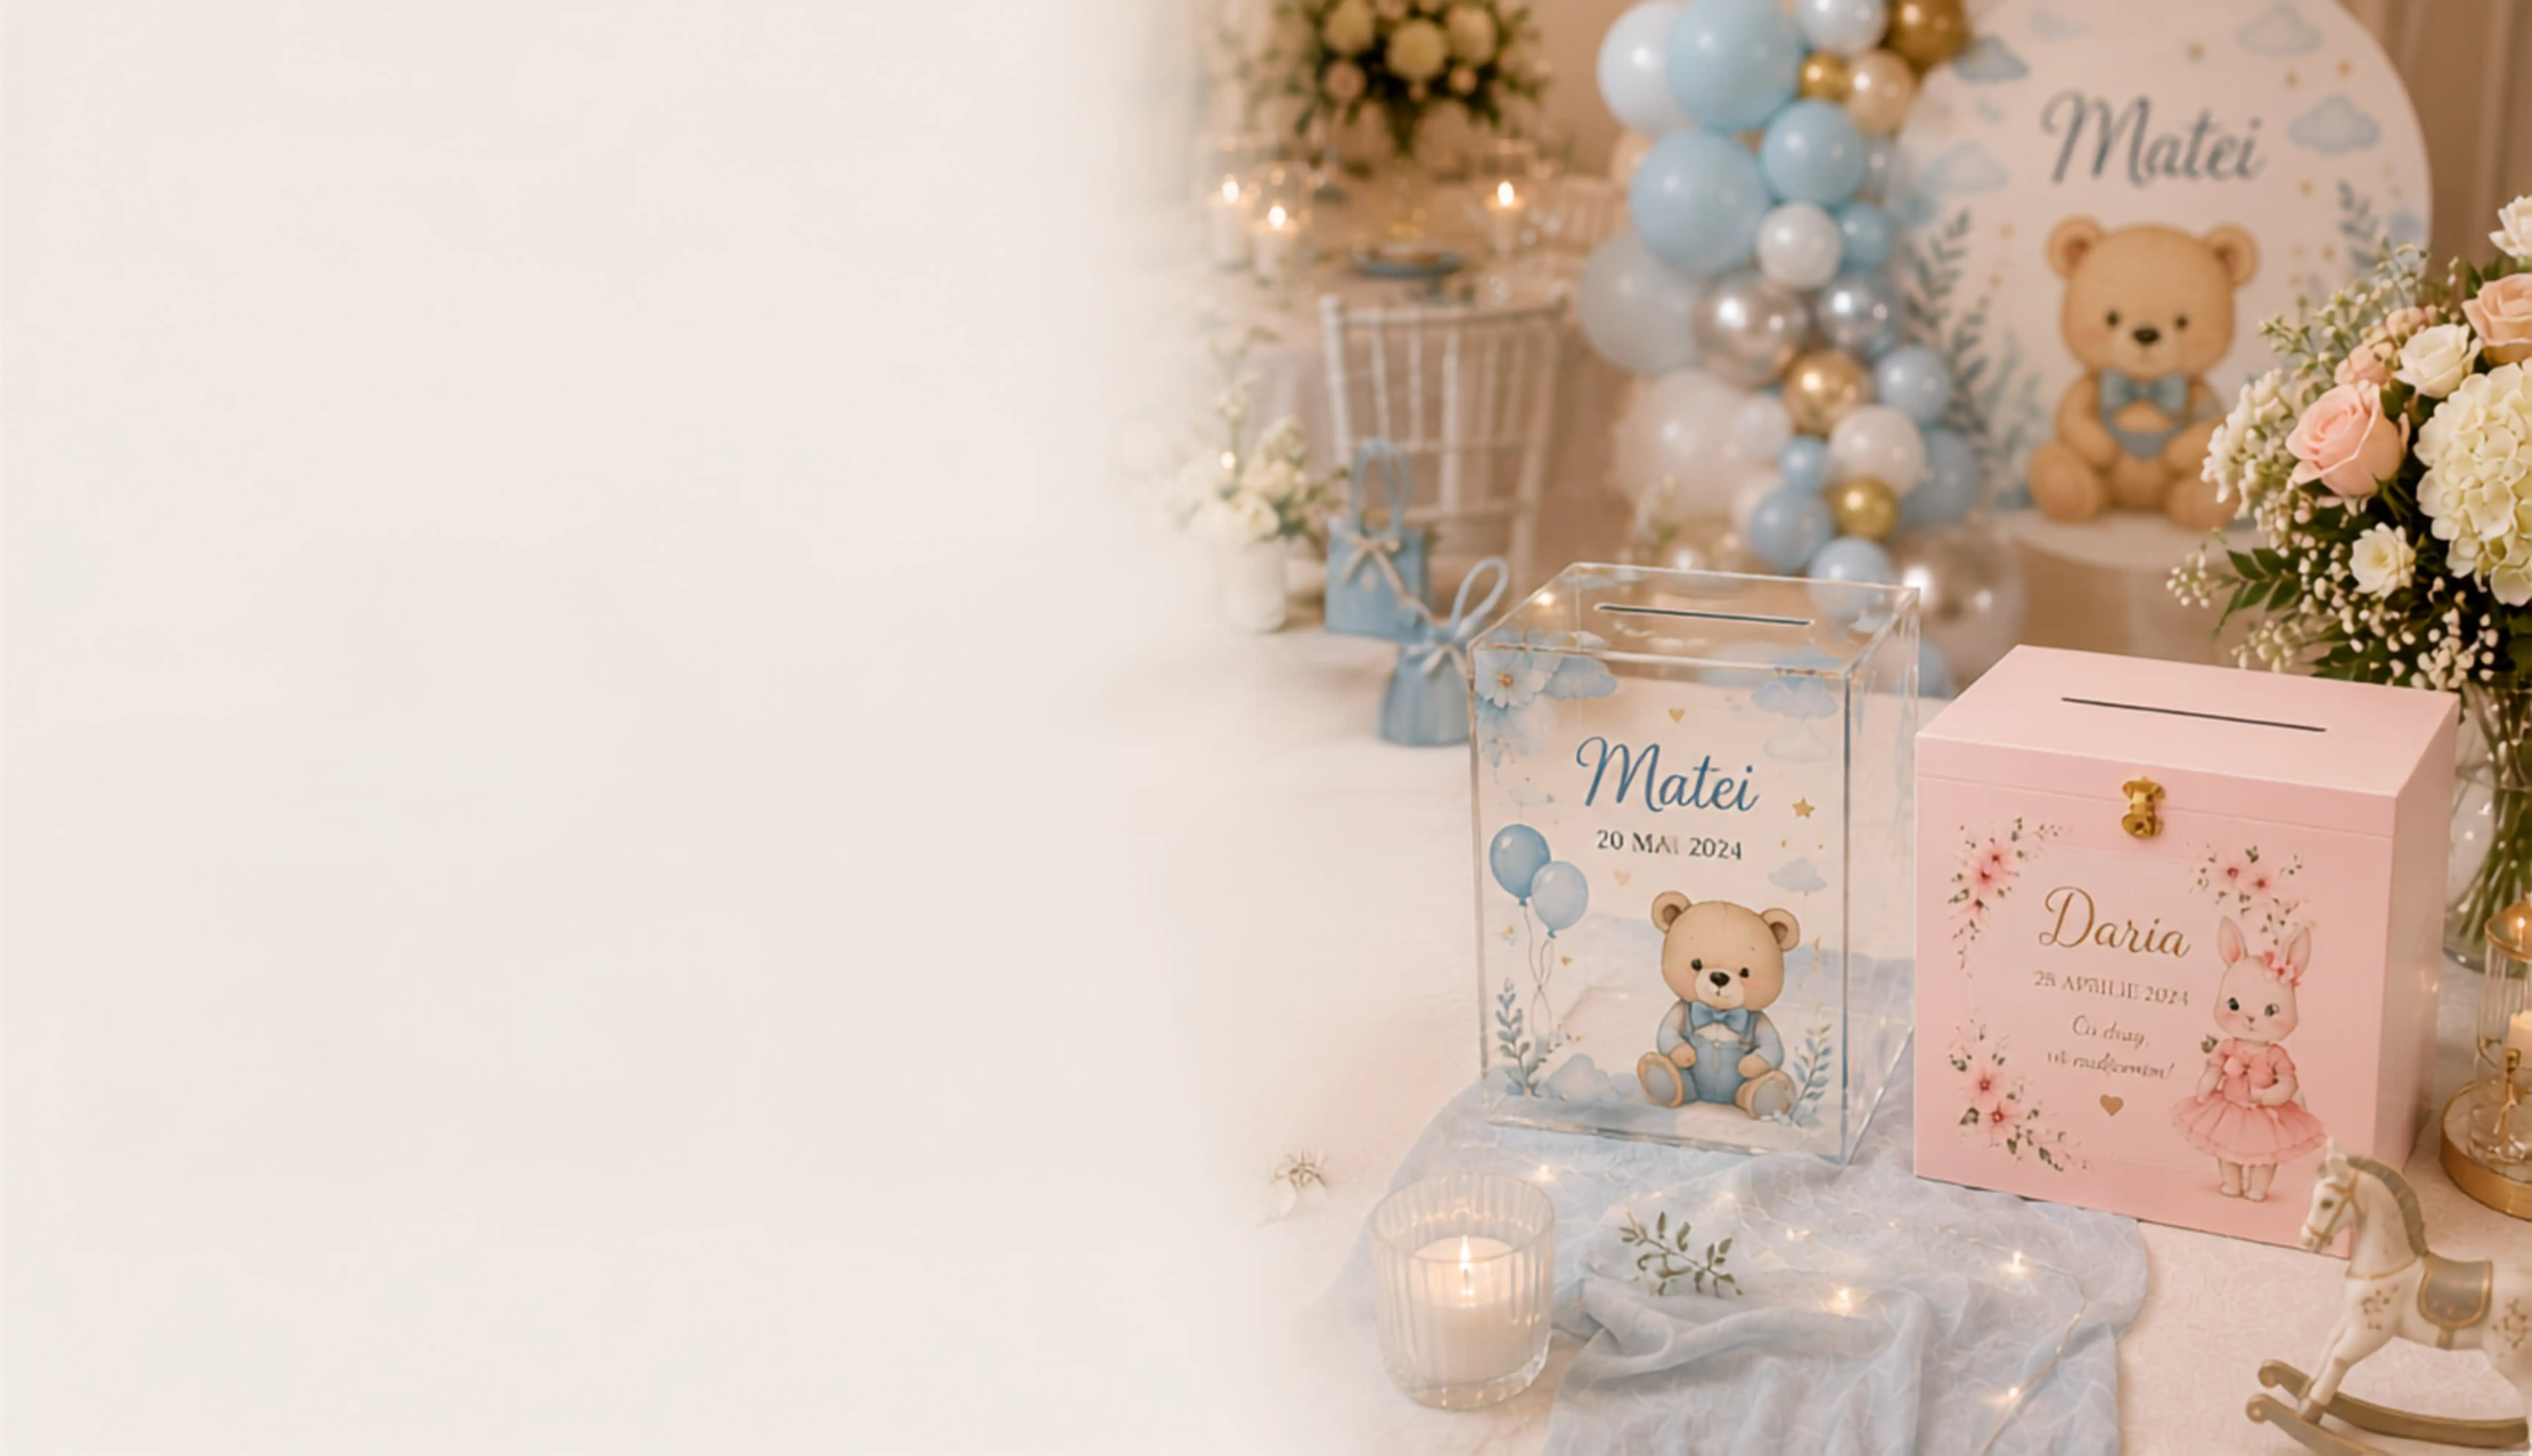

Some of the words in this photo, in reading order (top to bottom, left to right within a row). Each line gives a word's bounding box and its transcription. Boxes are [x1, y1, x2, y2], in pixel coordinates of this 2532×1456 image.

[2039, 90, 2267, 189] Matei
[1576, 736, 1760, 813] Matei
[1597, 829, 1624, 850] 20
[1632, 832, 1679, 855] MAI
[1688, 837, 1742, 860] 2024
[2038, 886, 2191, 958] Daria
